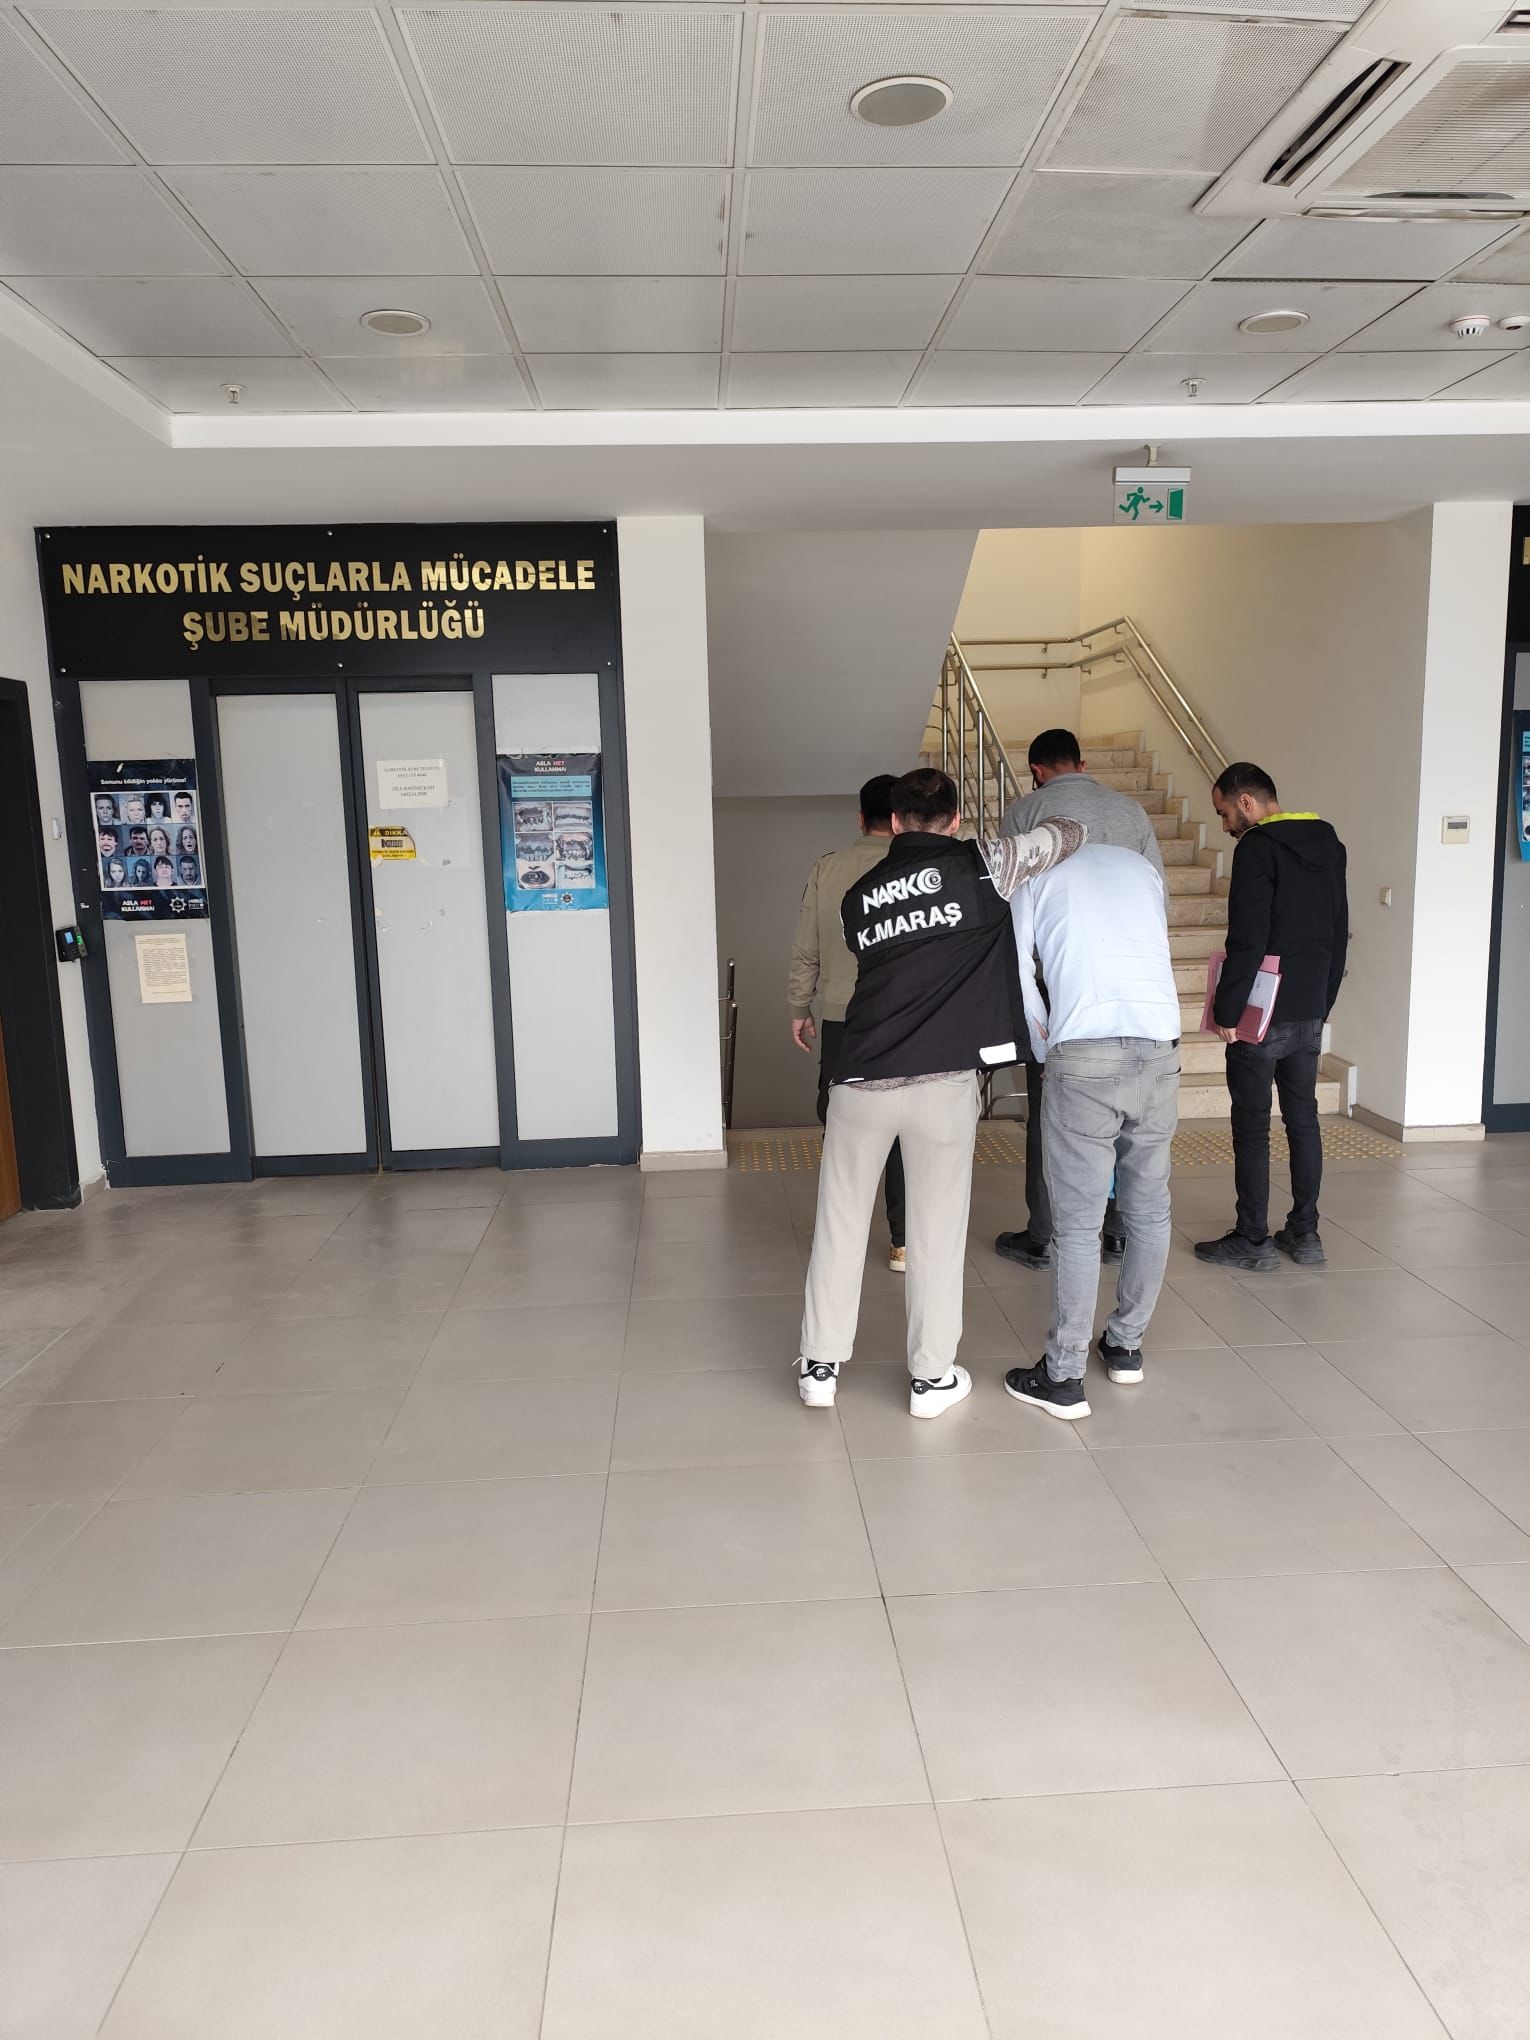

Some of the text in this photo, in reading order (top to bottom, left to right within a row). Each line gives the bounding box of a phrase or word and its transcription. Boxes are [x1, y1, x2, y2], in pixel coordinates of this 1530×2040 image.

[62, 553, 595, 601] NARKOTİK SUÇLARLA MÜCADELE
[183, 599, 485, 651] ŞUBE MÜDÜRLÜĞÜ
[857, 902, 963, 951] K.MARAŞ
